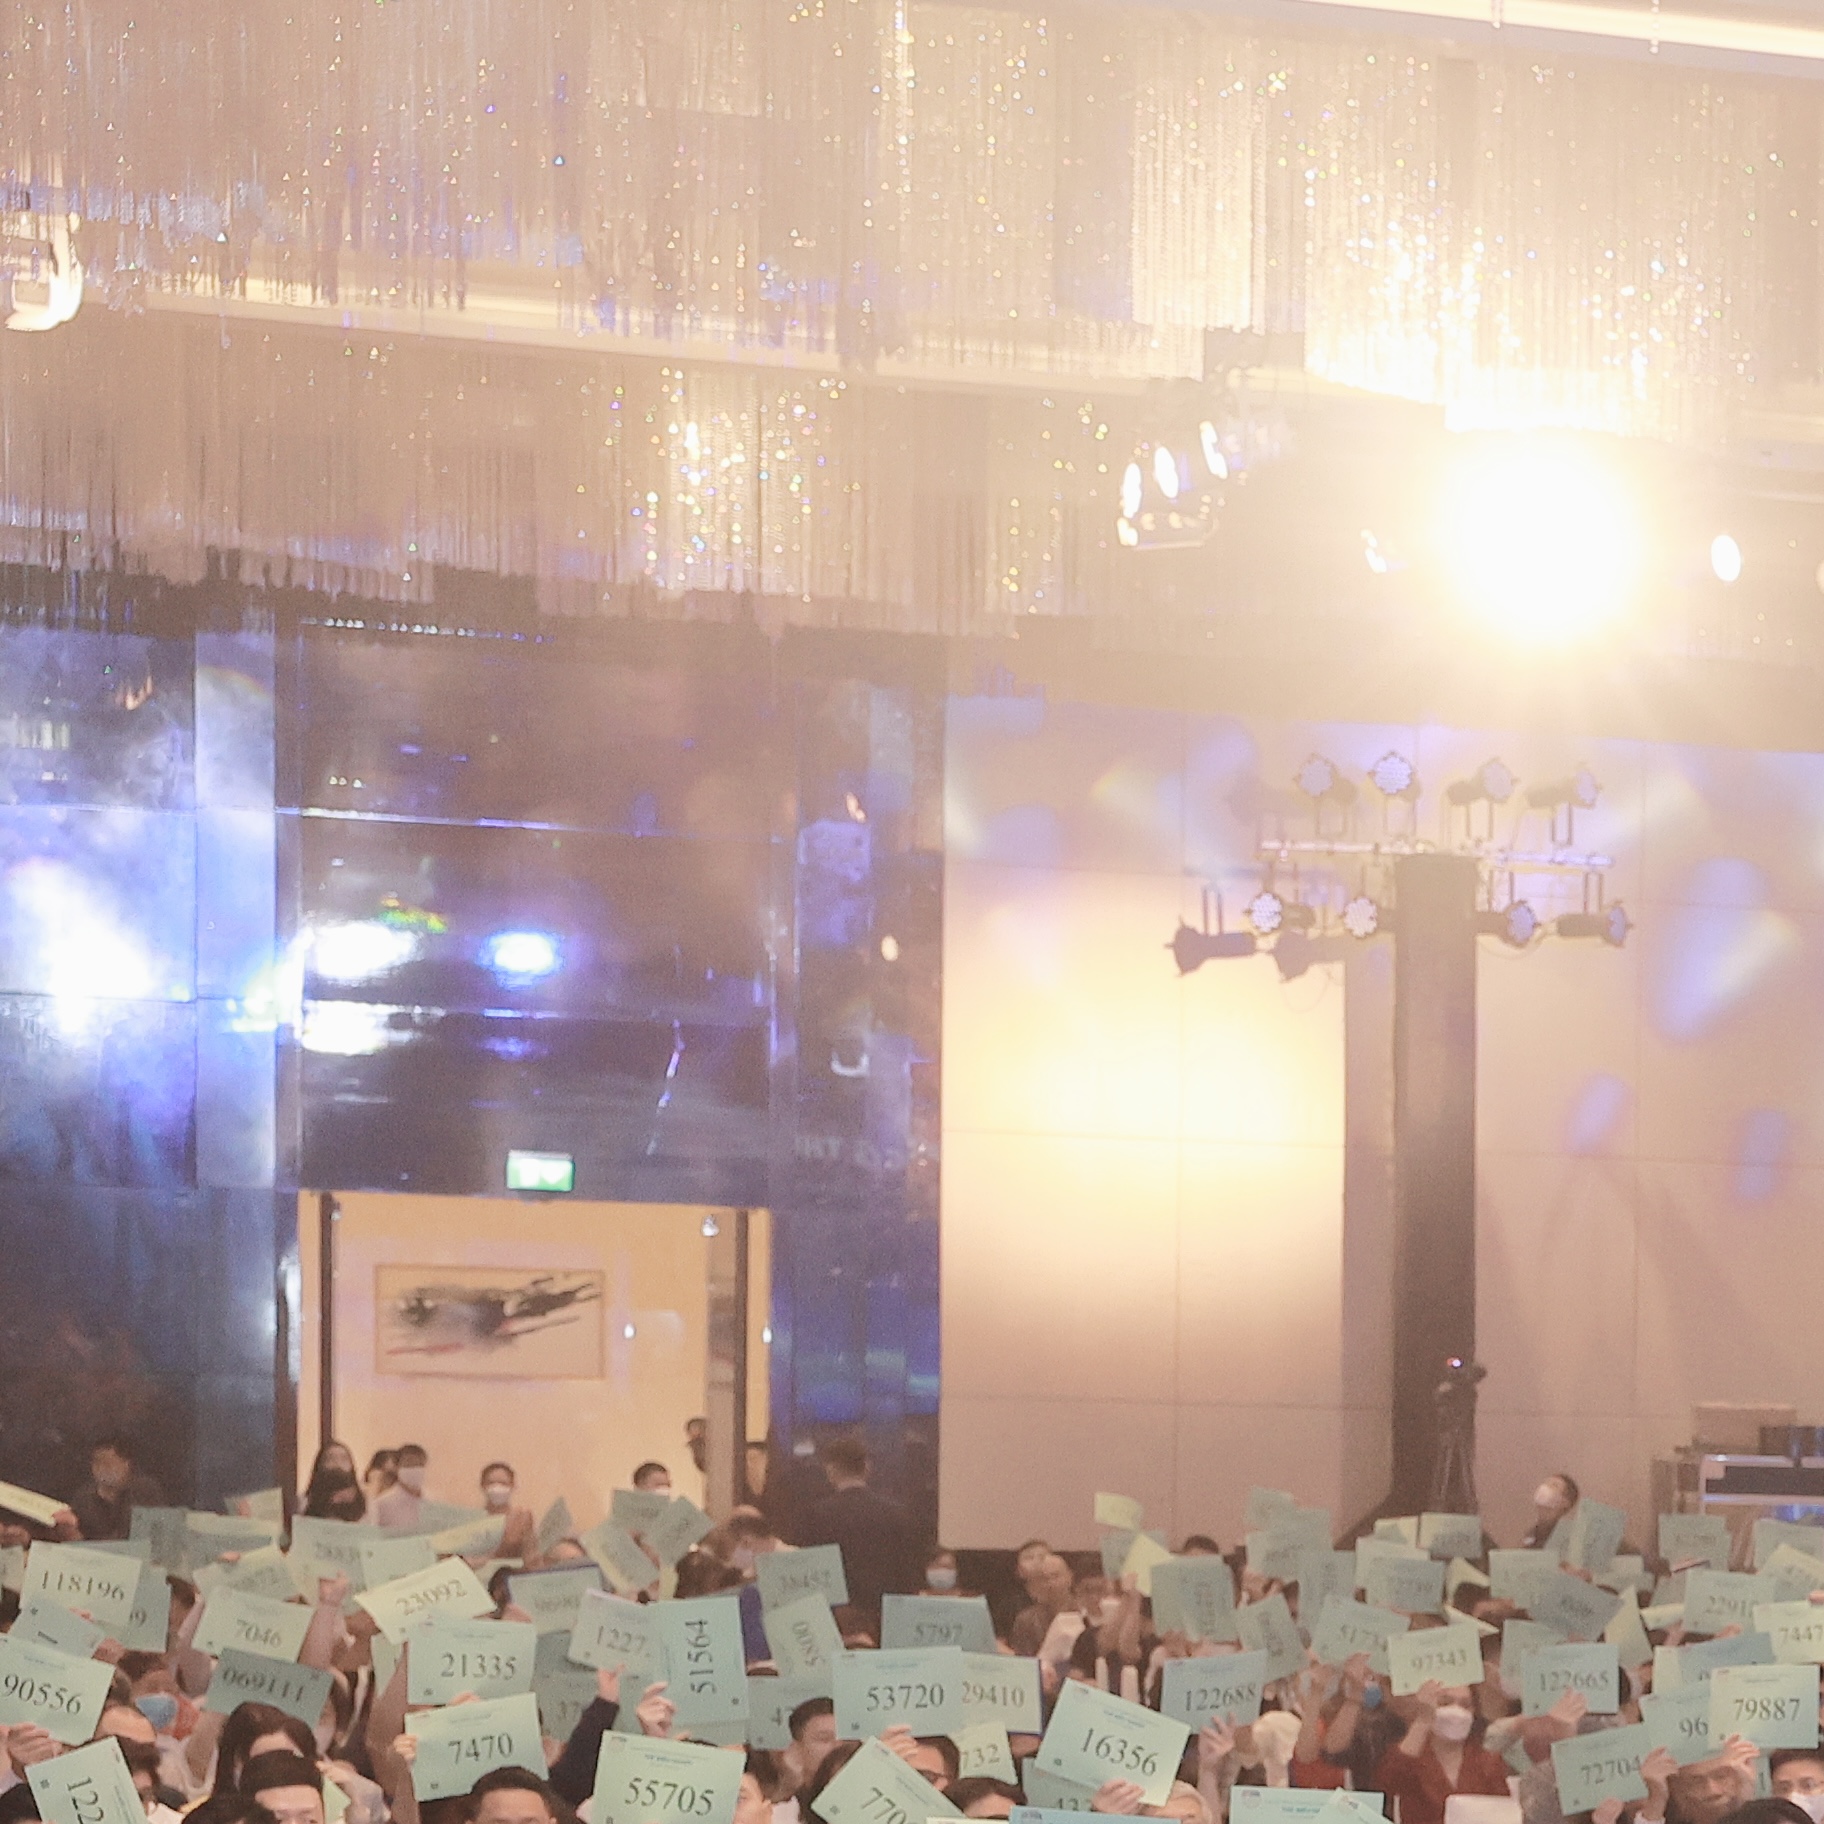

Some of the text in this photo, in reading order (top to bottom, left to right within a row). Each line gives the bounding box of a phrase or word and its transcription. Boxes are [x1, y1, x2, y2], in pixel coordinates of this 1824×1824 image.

[237, 1619, 281, 1647] 7046
[441, 1652, 516, 1680] 21335
[685, 1619, 716, 1693] 51564
[4, 1675, 81, 1714] 90556
[962, 1681, 1024, 1707] 29410
[1539, 1671, 1609, 1692] 122665
[867, 1684, 944, 1711] 53720
[1186, 1683, 1256, 1712] 122688
[1734, 1698, 1800, 1720] 79887
[448, 1733, 513, 1764] 7470
[1082, 1728, 1158, 1776] 16356
[1580, 1756, 1642, 1785] 72704
[625, 1777, 714, 1815] 55705
